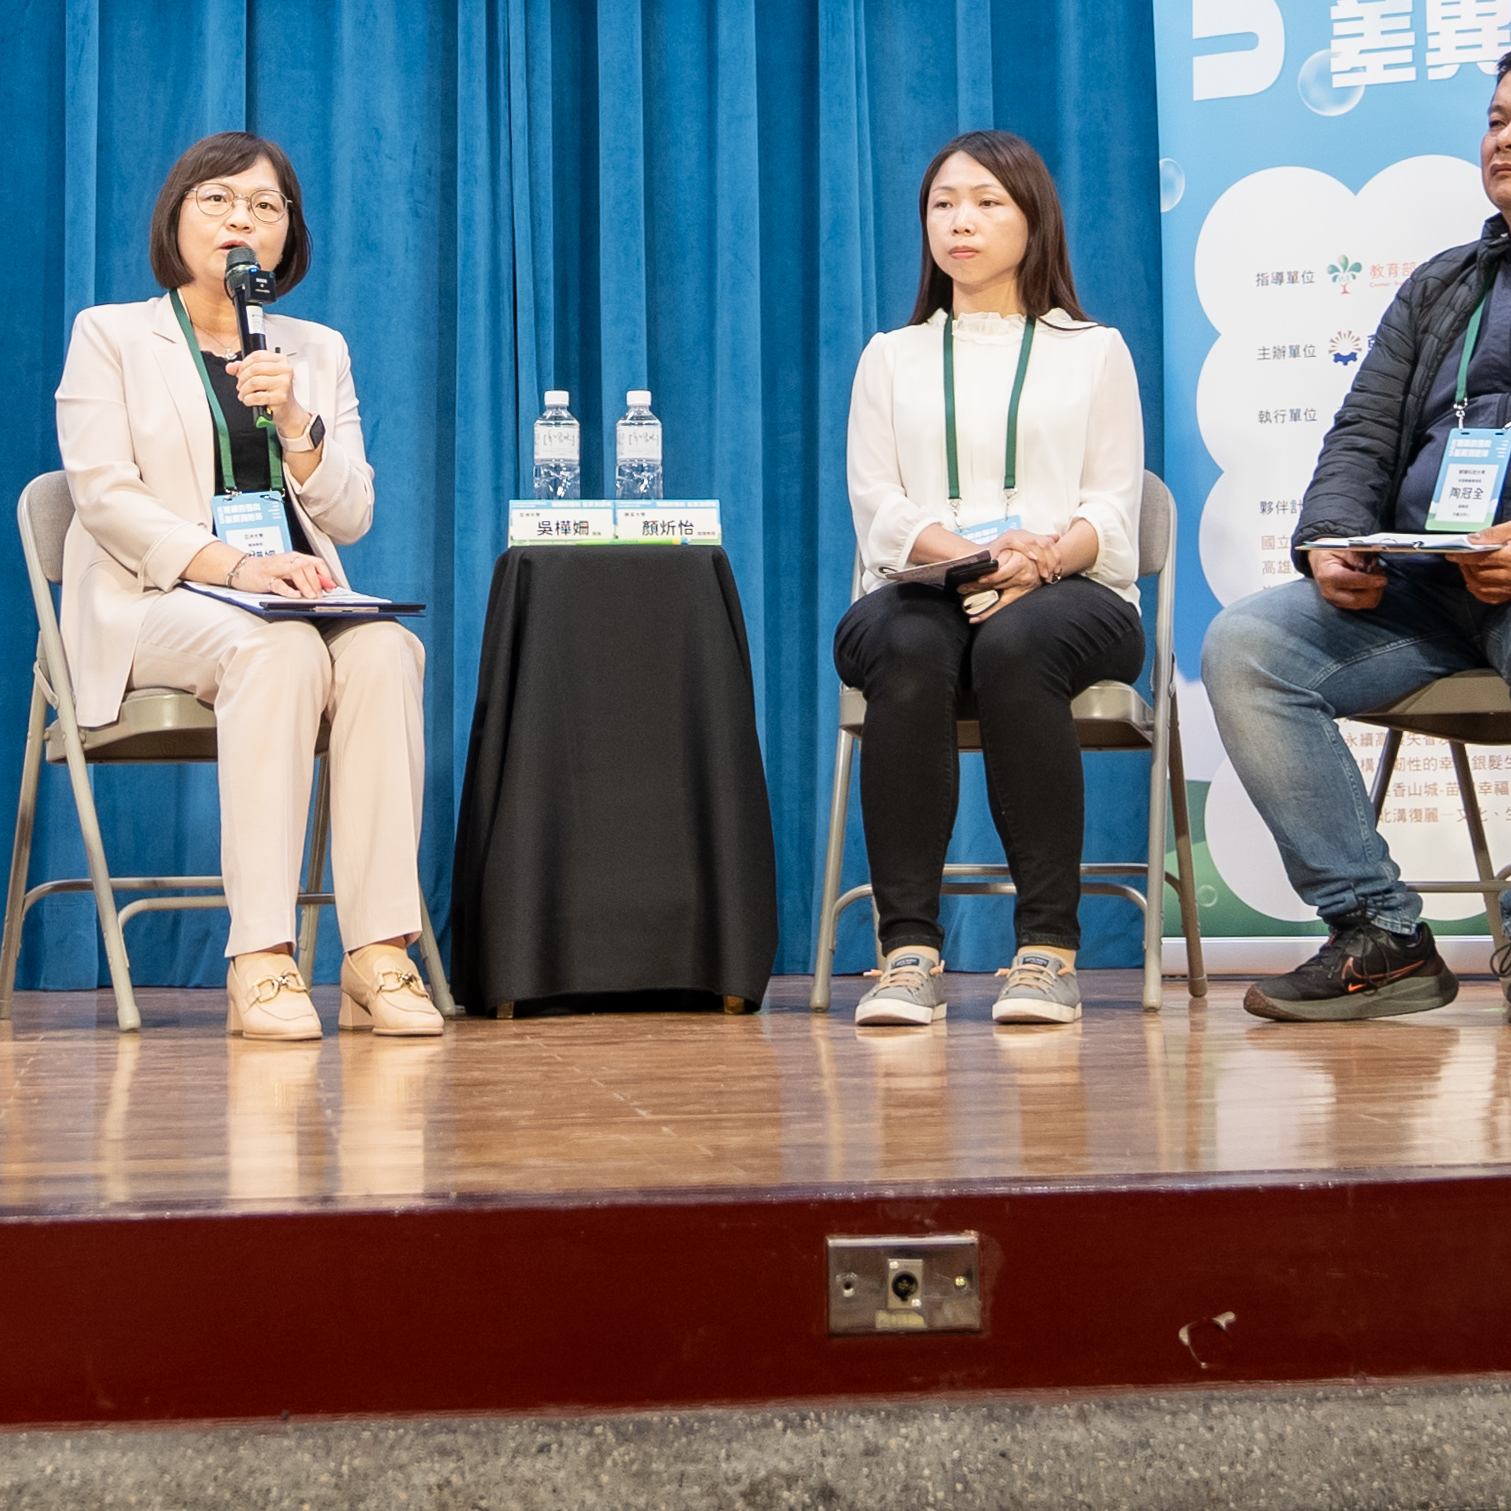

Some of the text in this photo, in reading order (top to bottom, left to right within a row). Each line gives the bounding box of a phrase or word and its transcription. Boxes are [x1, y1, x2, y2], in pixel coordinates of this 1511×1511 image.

[1256, 270, 1315, 287] 指導單位
[1257, 345, 1316, 360] 主辦單位
[1258, 408, 1318, 424] 執行單位
[1262, 560, 1301, 575] 高雄
